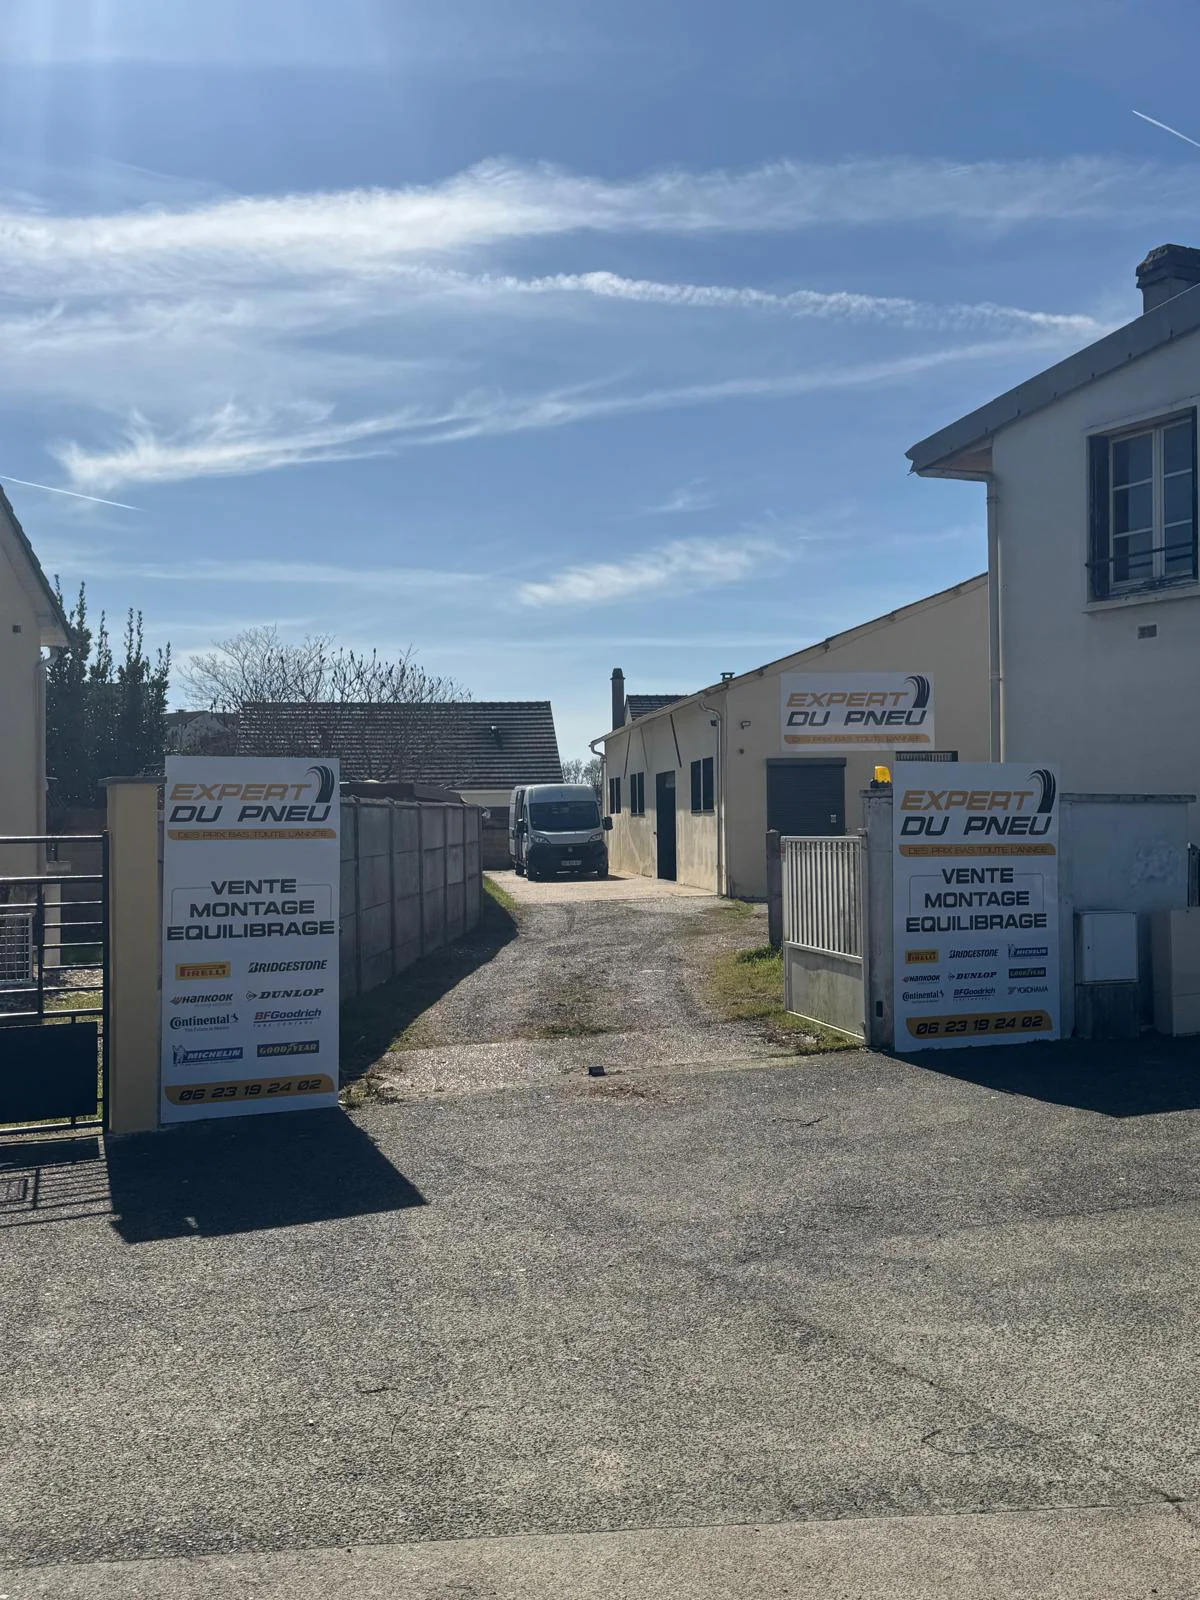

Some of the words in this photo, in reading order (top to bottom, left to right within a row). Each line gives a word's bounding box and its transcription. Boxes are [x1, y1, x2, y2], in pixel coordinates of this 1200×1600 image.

[786, 692, 909, 707] EXPERT
[786, 711, 831, 726] DU
[843, 710, 927, 726] PNEU
[169, 783, 312, 801] EXPERT
[900, 790, 1034, 811] EXPERT
[169, 805, 223, 823] DU
[237, 805, 331, 822] PNEU
[900, 816, 950, 836] DU
[963, 816, 1052, 836] PNEU
[941, 867, 1014, 884] VENTE
[211, 878, 296, 895] VENTE
[924, 890, 1030, 909] MONTAGE
[190, 900, 315, 918] MONTAGE
[167, 920, 335, 941] EQUILIBRAGE
[906, 913, 1047, 933] EQUILIBRAGE
[948, 949, 1000, 959] BRIDGESTONE
[180, 963, 227, 978] PIRELLI
[248, 959, 328, 974] BRIDGESTONE
[955, 971, 997, 980] DUNLOP
[259, 988, 325, 1000] DUNLOP
[902, 989, 940, 1002] Continental
[953, 987, 996, 996] BFGoodrich
[170, 1014, 230, 1031] Continental
[254, 1008, 322, 1021] BFGoodrich
[916, 1022, 939, 1035] 06
[944, 1020, 968, 1033] 23
[974, 1019, 989, 1031] 19
[994, 1017, 1016, 1030] 24
[1021, 1015, 1043, 1028] 02
[187, 1048, 242, 1060] MICHELIN
[179, 1088, 207, 1101] 06
[211, 1086, 238, 1098] 23
[244, 1084, 262, 1096] 19
[267, 1081, 292, 1094] 24
[297, 1079, 322, 1091] 02
